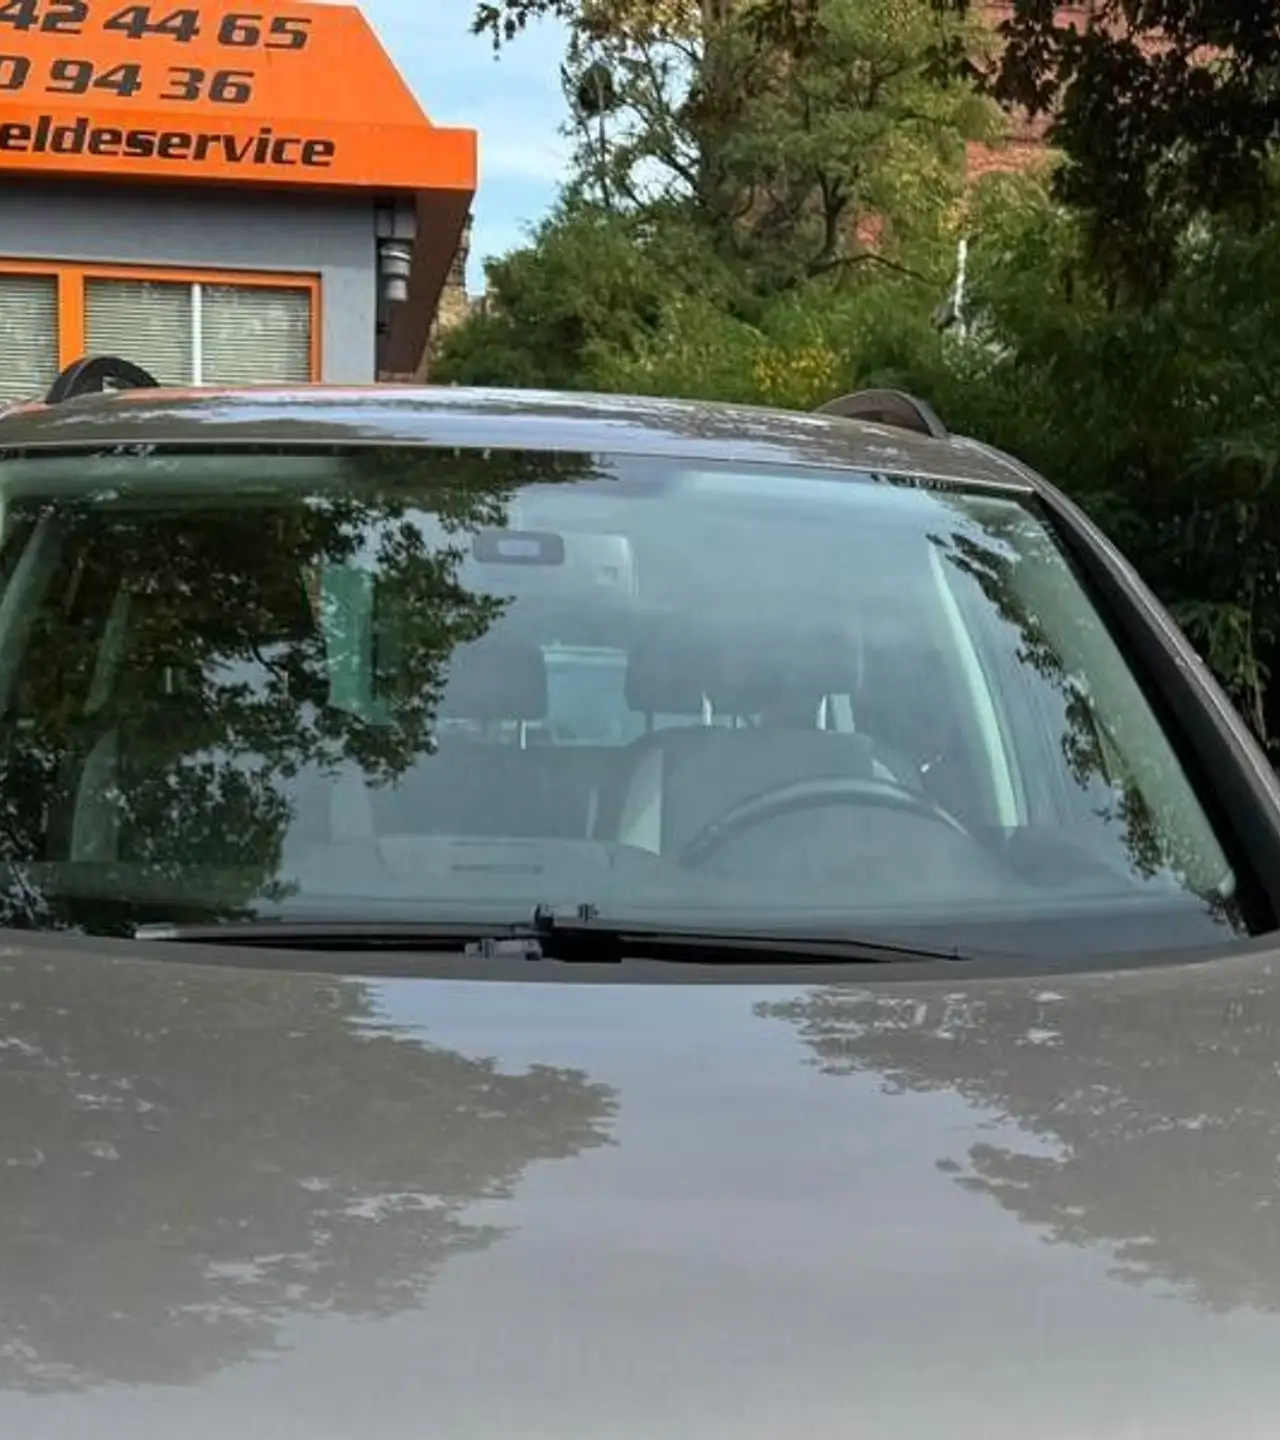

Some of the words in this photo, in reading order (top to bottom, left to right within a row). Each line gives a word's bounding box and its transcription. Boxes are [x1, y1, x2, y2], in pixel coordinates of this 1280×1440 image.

[103, 5, 200, 42] 44
[217, 13, 312, 50] 65
[45, 59, 142, 97] 94
[160, 67, 254, 104] 36
